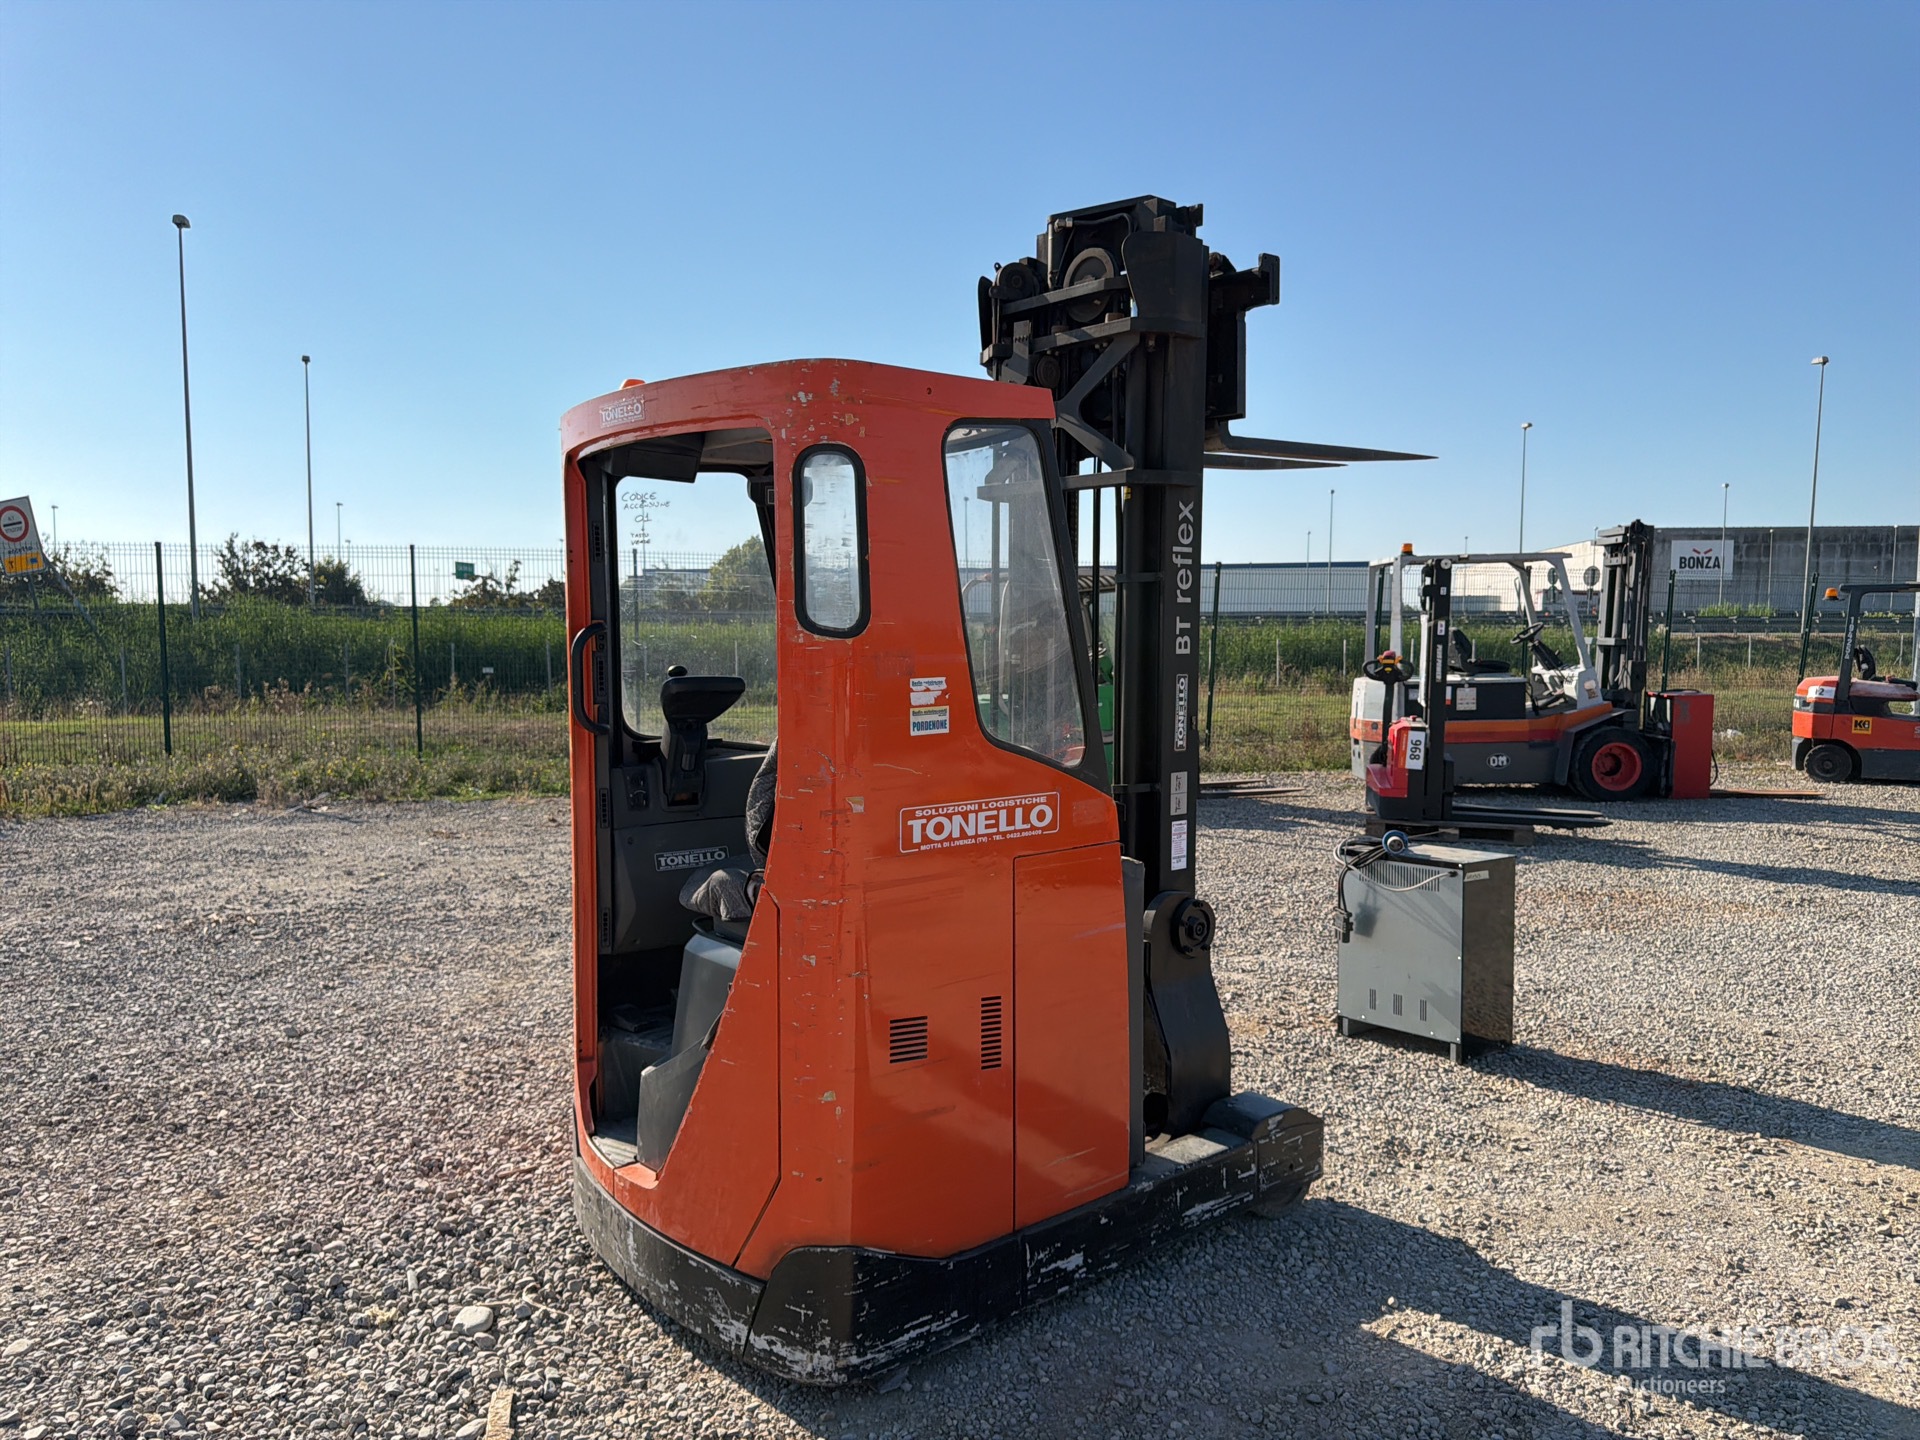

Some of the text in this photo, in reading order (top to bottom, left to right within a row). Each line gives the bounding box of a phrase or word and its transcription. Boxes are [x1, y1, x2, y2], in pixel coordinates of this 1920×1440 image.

[621, 491, 657, 502] CODICE
[1679, 556, 1721, 569] BONZA
[1172, 500, 1194, 655] BT reflex
[1177, 677, 1186, 748] TONELLO
[912, 719, 947, 732] PORDENONE
[1409, 739, 1422, 761] 968
[1489, 755, 1507, 767] OM
[915, 796, 1047, 817] SOLUZIONI LOGISTICHE
[907, 804, 1053, 844] TONELLO
[920, 843, 942, 851] MOTTA
[950, 838, 976, 847] LIVENZA
[658, 850, 726, 867] TONELLO
